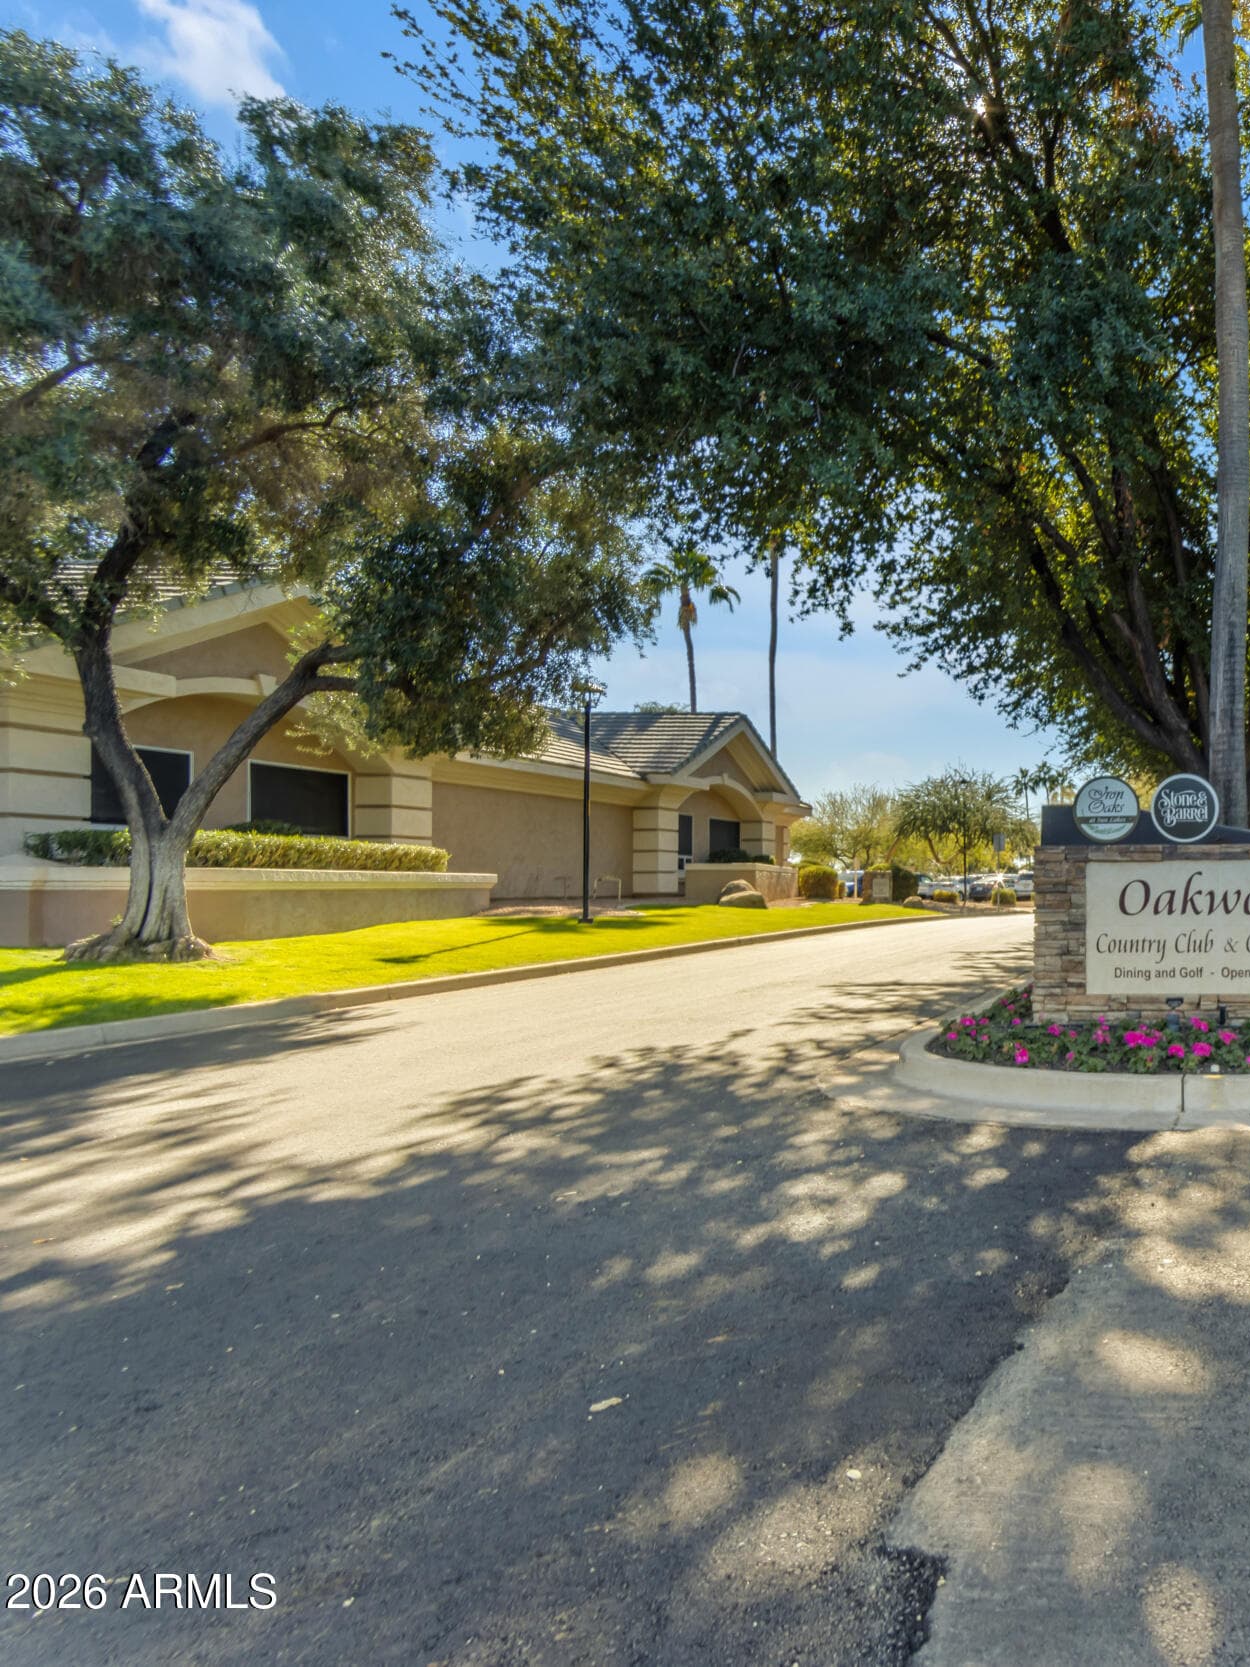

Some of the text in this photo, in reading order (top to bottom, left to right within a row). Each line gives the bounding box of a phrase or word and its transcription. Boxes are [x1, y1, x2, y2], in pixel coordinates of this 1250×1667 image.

[1088, 800, 1124, 814] Oaks
[1095, 932, 1167, 963] Country
[1174, 929, 1214, 954] Club
[1224, 937, 1239, 954] &
[1113, 966, 1151, 981] Dining
[1154, 966, 1176, 978] and
[1179, 966, 1204, 978] Golf
